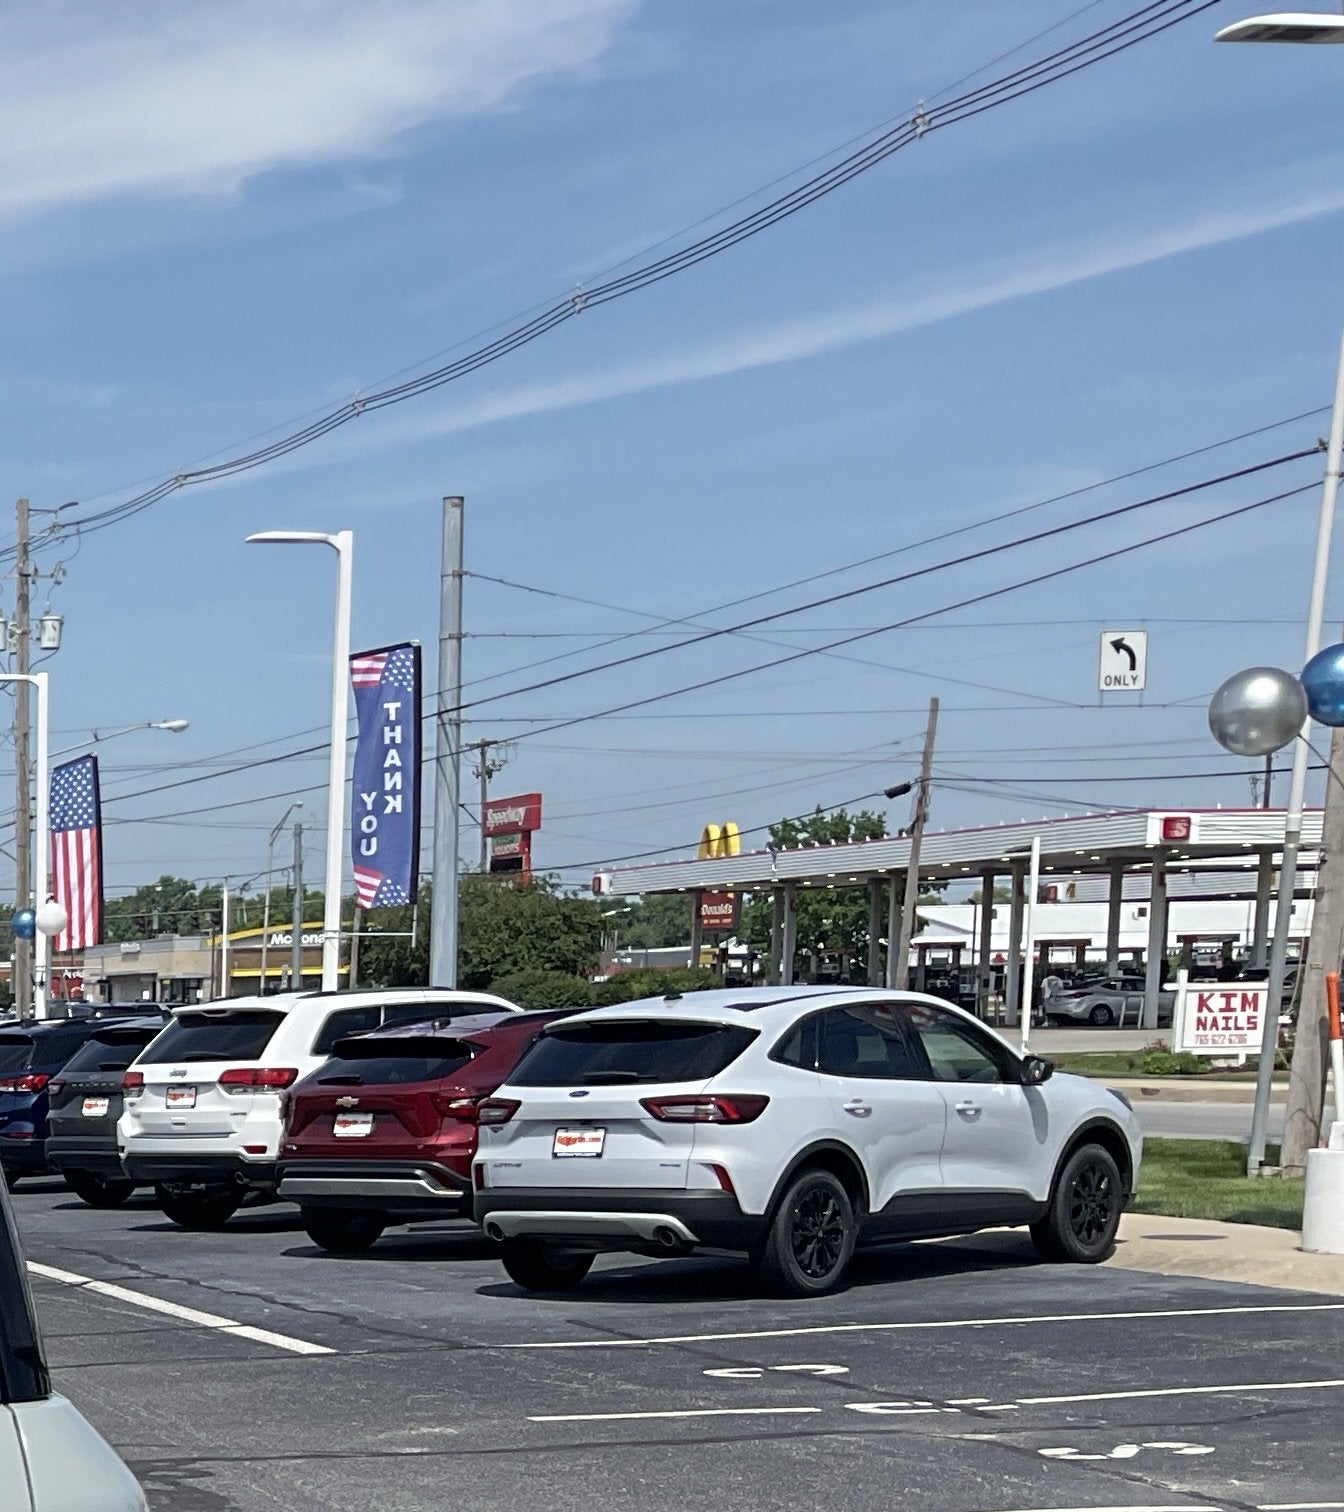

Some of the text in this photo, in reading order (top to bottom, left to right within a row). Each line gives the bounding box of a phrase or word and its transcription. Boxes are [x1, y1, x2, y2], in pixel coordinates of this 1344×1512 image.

[1104, 674, 1138, 686] ONLY
[1197, 992, 1259, 1013] KIM
[1196, 1016, 1258, 1031] NAILS
